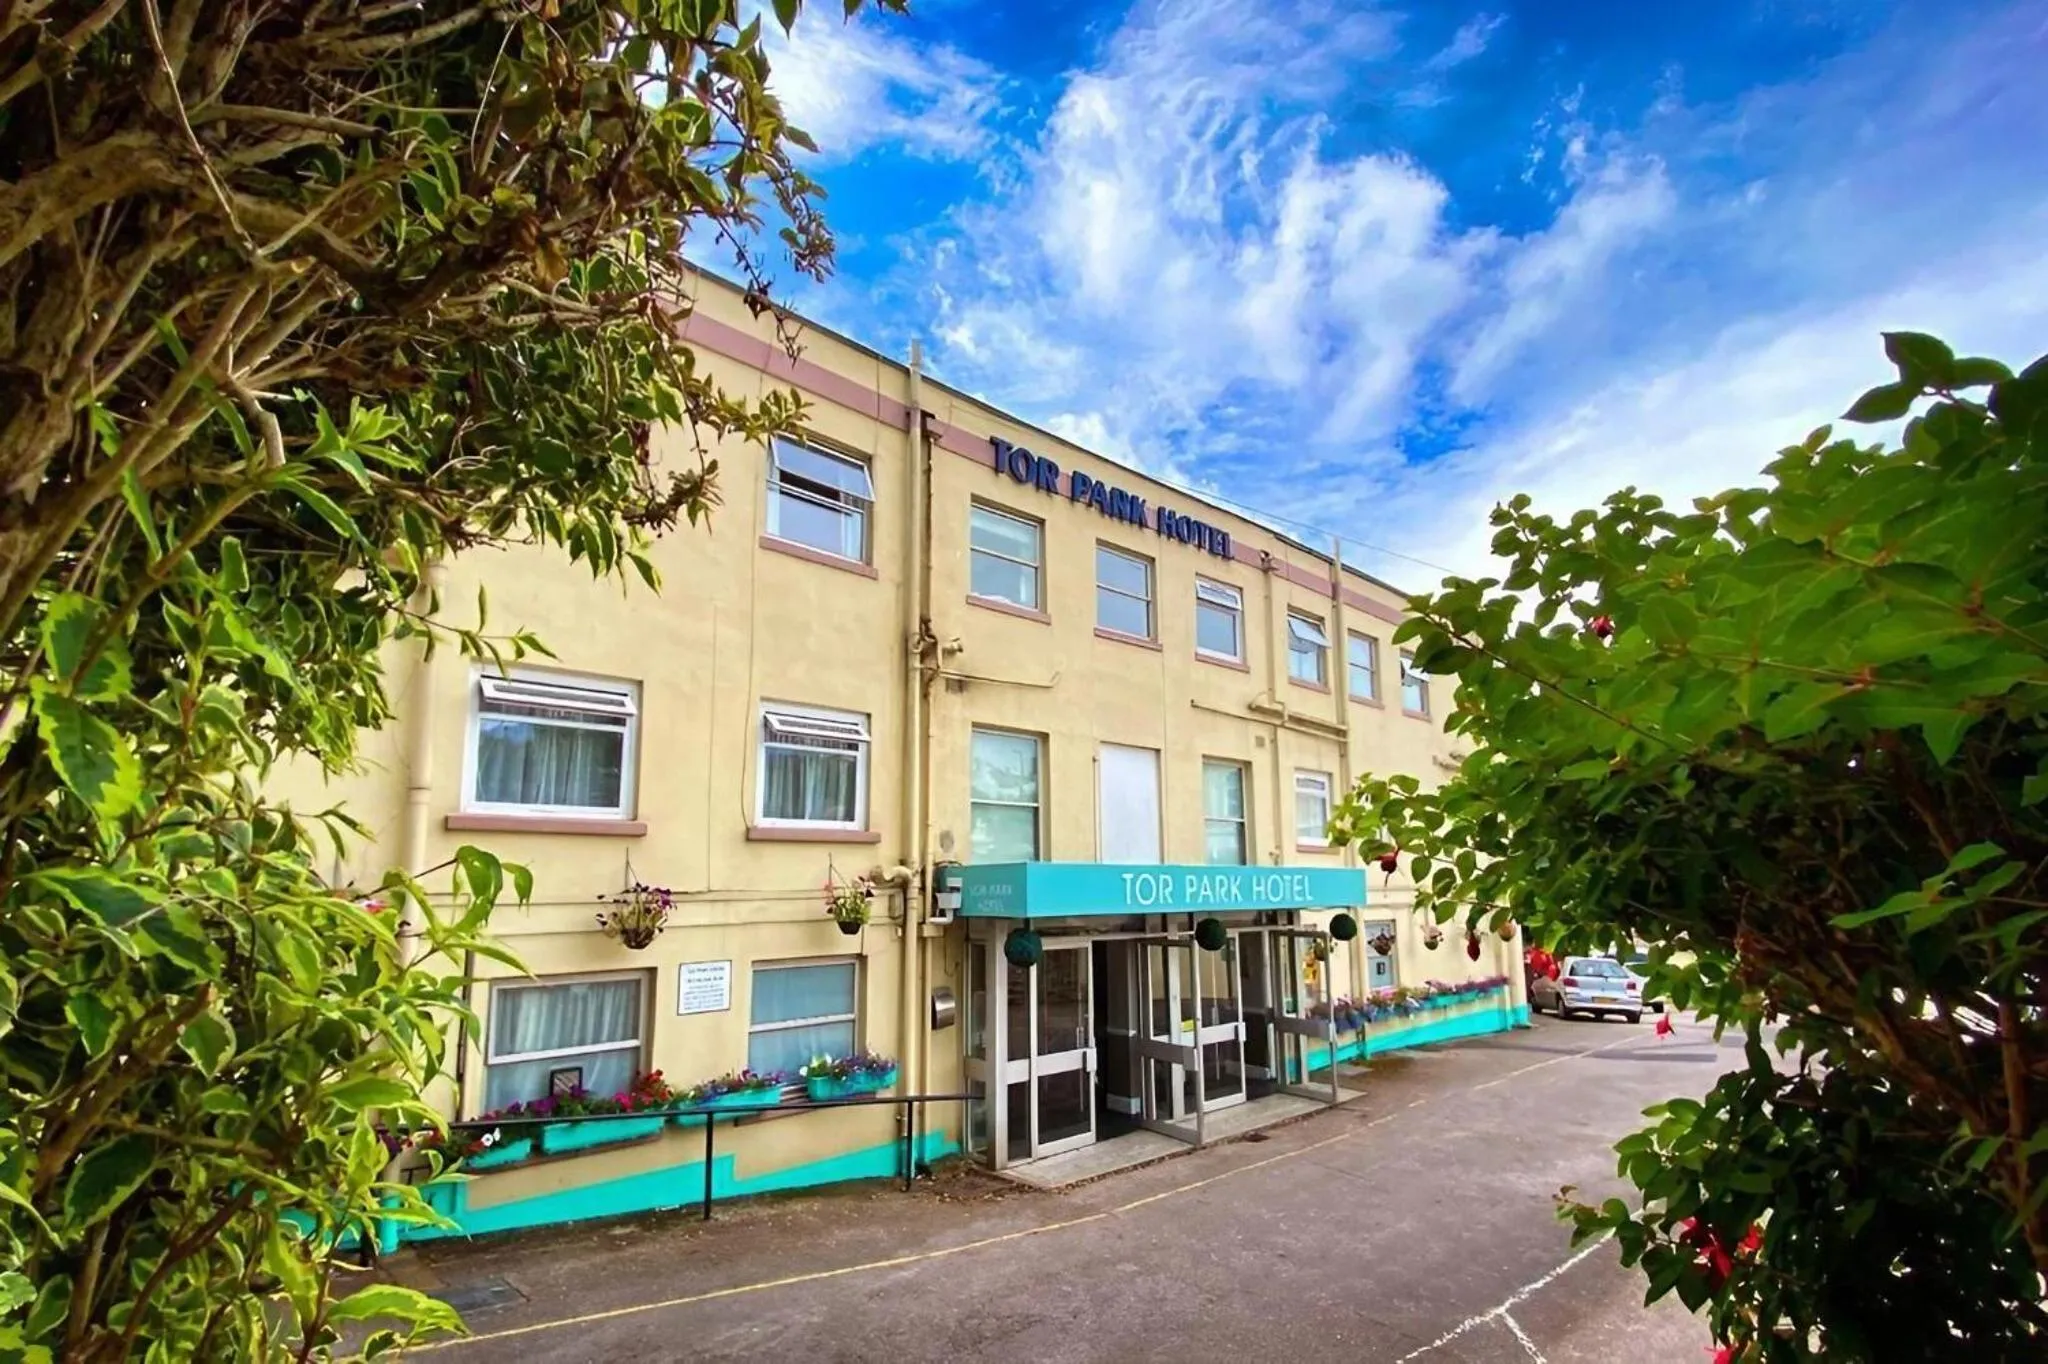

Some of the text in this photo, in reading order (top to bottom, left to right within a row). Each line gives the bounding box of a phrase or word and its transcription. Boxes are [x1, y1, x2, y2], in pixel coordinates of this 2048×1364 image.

[990, 436, 1234, 560] TOR PARK HOTEL
[1122, 873, 1314, 905] TOR PARK HOTEL
